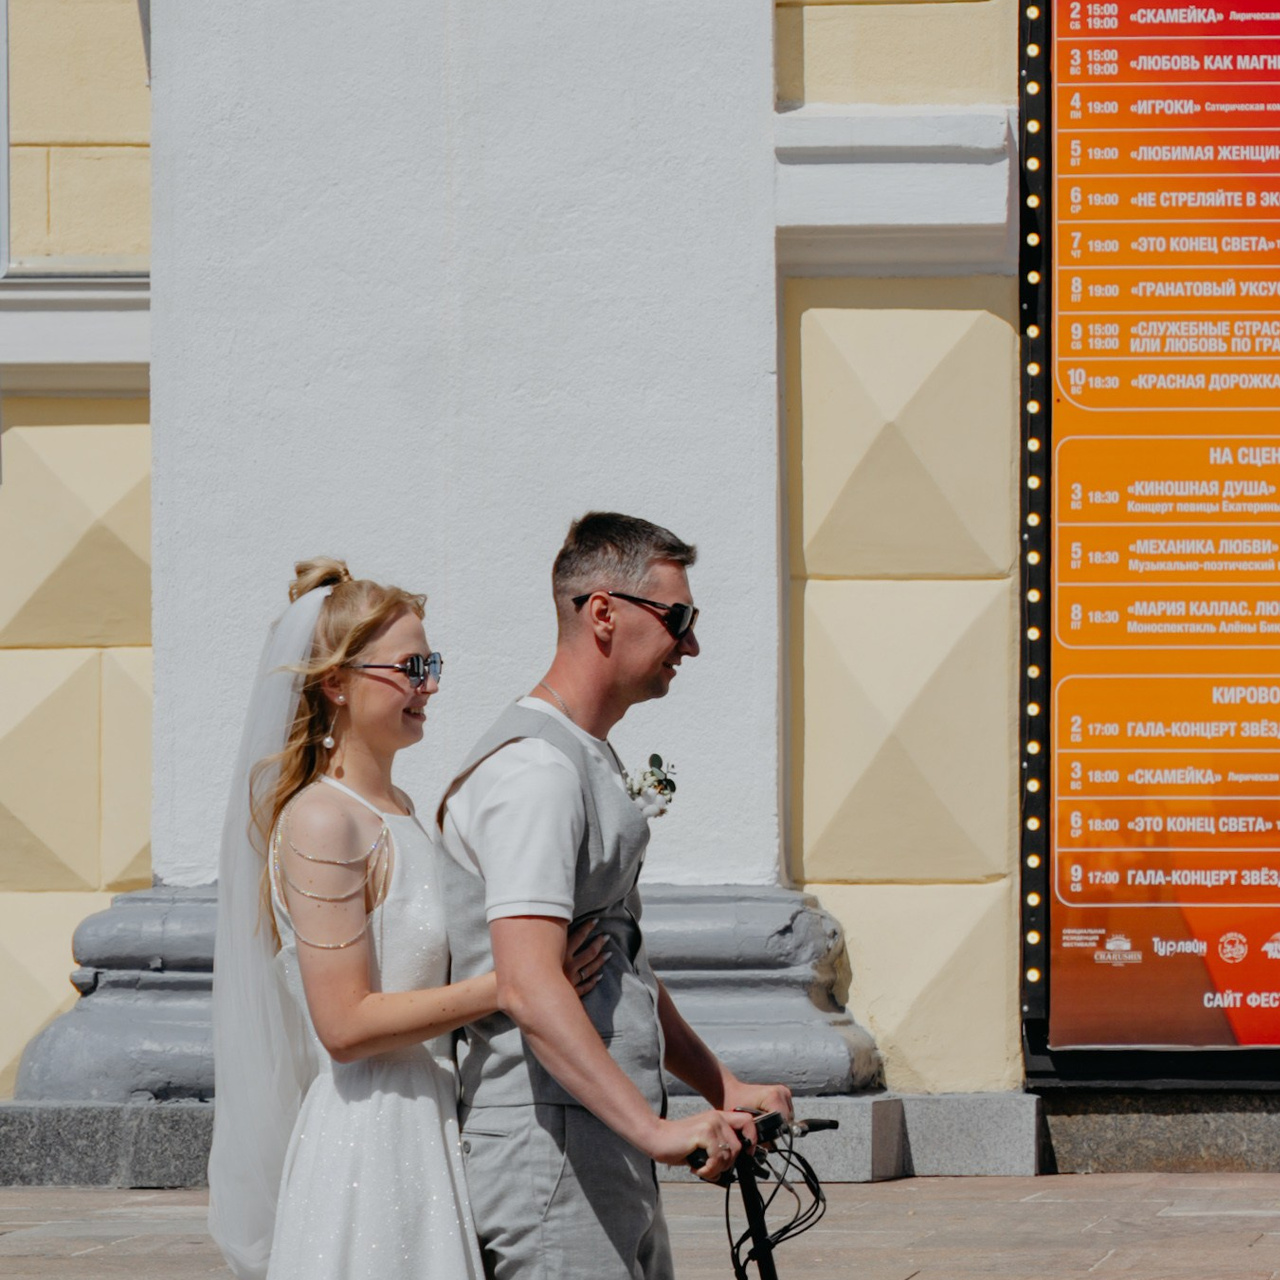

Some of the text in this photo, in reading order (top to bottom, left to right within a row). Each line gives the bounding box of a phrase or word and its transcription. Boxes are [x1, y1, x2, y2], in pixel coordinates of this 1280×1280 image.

[1087, 3, 1118, 16] 15:00
[1130, 5, 1224, 24] «СКАМЕЙКА»
[1087, 49, 1118, 61] 15:00
[1130, 55, 1200, 70] «ЛЮБОВЬ
[1204, 55, 1233, 70] КАК
[1130, 99, 1201, 115] «ИГРОКИ»
[1088, 147, 1119, 160] 19:00
[1130, 145, 1214, 161] «ЛЮБИМАЯ
[1087, 193, 1119, 206] 19:00
[1131, 192, 1156, 207] «НЕ
[1160, 189, 1243, 207] СТРЕЛЯЙТЕ
[1246, 191, 1257, 207] В
[1088, 236, 1275, 254] 19:00 «ЭТО КОНЕЦ СВЕТА»
[1088, 284, 1119, 297] 19:00
[1131, 278, 1236, 297] «ГРАНАТОВЫЙ
[1088, 323, 1119, 336] 15:00
[1131, 321, 1230, 336] «СЛУЖЕБНЫЕ
[1130, 336, 1161, 352] ИЛИ
[1164, 336, 1227, 353] ЛЮБОВЬ
[1231, 336, 1252, 352] ПО
[1087, 375, 1119, 389] 18:30
[1131, 373, 1205, 389] «КРАСНАЯ
[1209, 447, 1233, 464] НА
[1088, 480, 1276, 503] 18:30 «КИНОШНАЯ ДУША»
[1127, 500, 1173, 514] Концерт
[1088, 539, 1279, 564] 18:30 «МЕХАНИКА ЛЮБВИ»
[1128, 559, 1275, 573] Музыкально-поэтический
[1088, 611, 1120, 623] 18:30
[1127, 601, 1186, 616] «МАРИЯ
[1189, 601, 1252, 616] КАЛЛАС.
[1088, 723, 1120, 736] 17:00
[1127, 721, 1237, 739] ГАЛА-КОНЦЕРТ
[1127, 766, 1221, 784] «СКАМЕЙКА»
[1127, 816, 1273, 834] «ЭТО КОНЕЦ СВЕТА»
[1088, 871, 1119, 884] 17:00
[1127, 869, 1238, 887] ГАЛА-КОНЦЕРТ
[1203, 990, 1243, 1008] САЙТ
